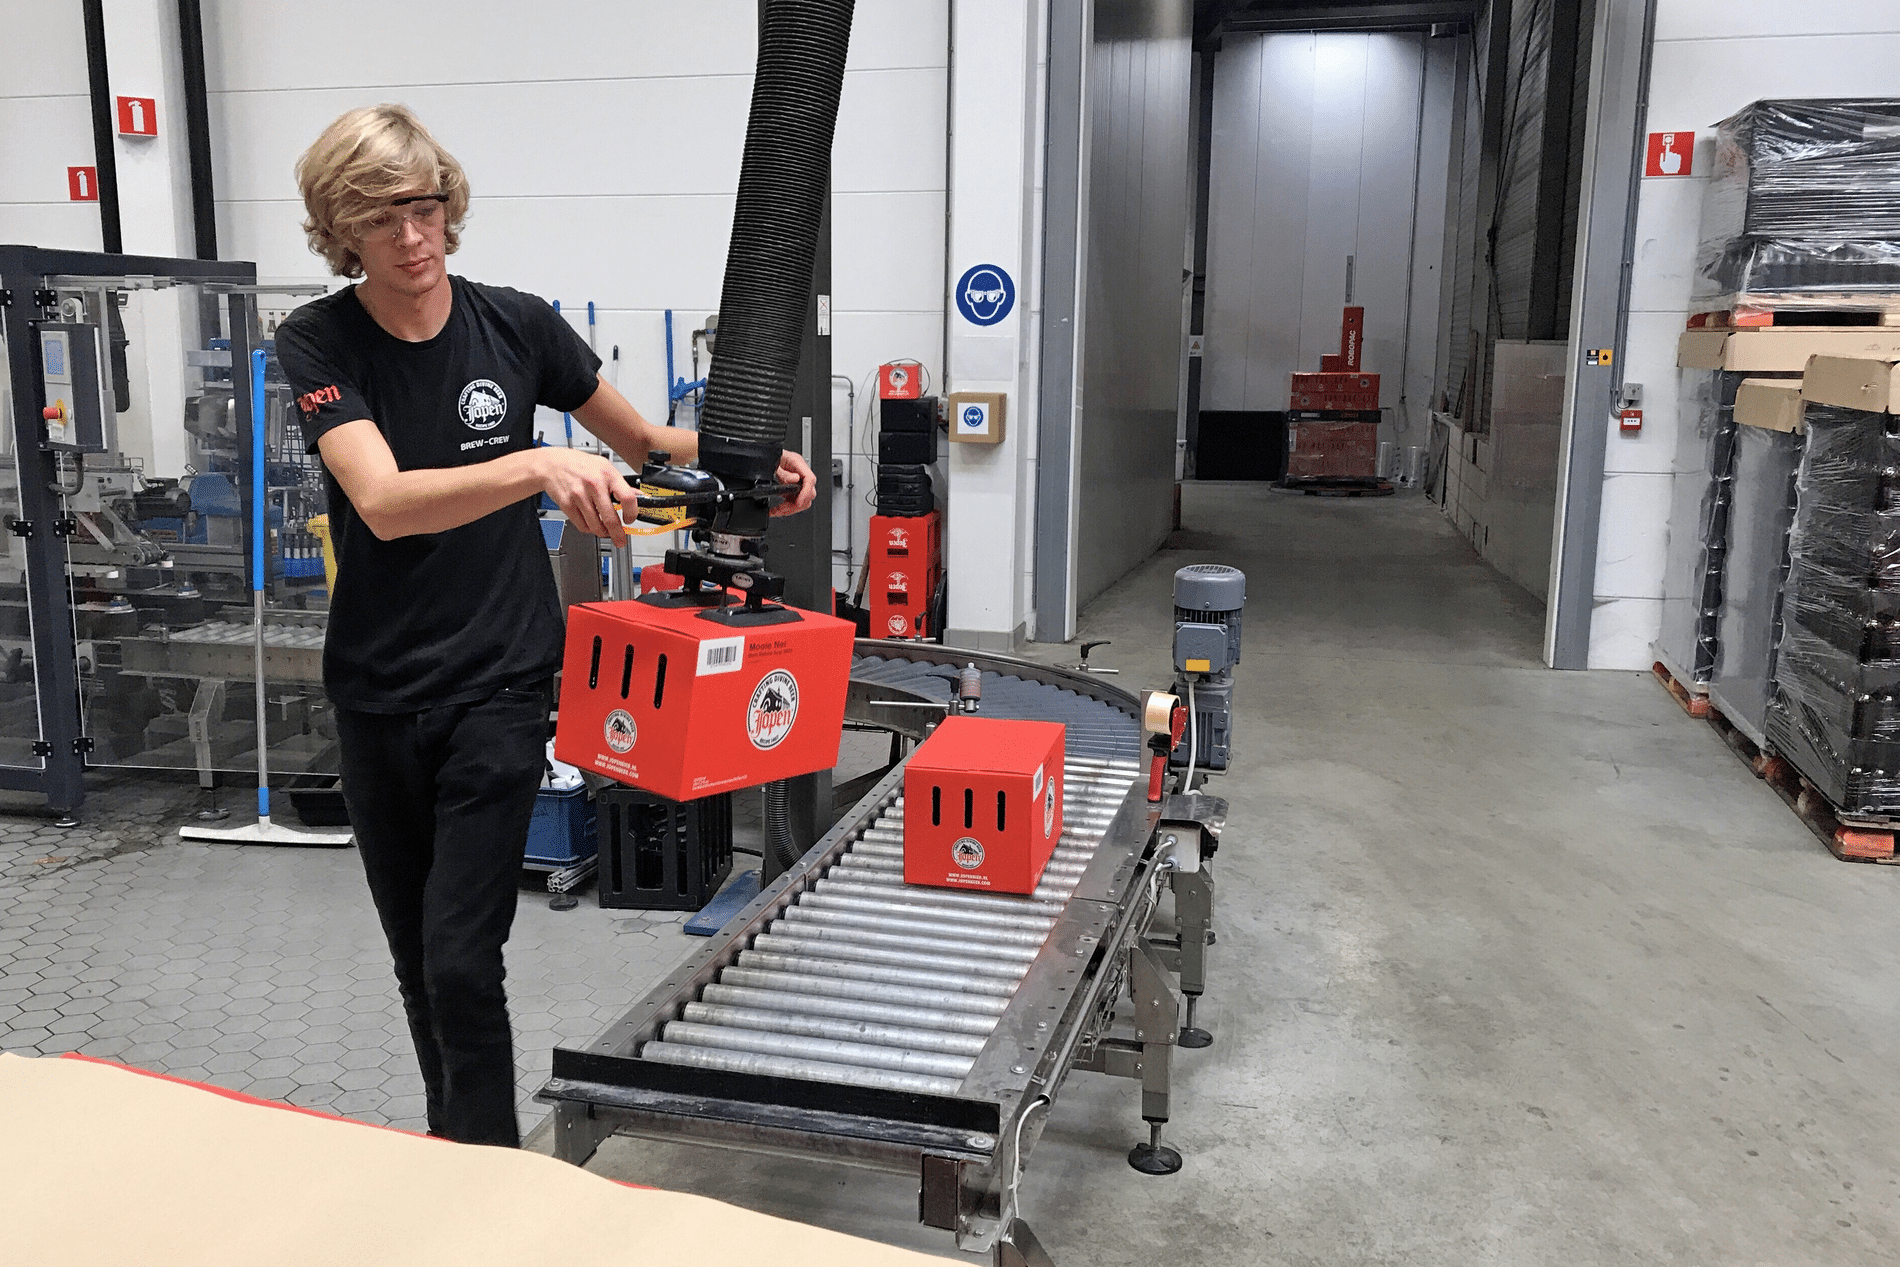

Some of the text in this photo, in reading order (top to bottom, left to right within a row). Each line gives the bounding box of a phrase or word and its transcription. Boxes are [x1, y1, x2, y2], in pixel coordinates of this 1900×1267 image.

[1348, 330, 1356, 366] ROBOPAC
[462, 403, 504, 425] Jopen
[460, 435, 510, 451] BREW-CREW
[752, 675, 796, 708] CRAFTING DIVINE BEER
[751, 709, 791, 738] Jopen
